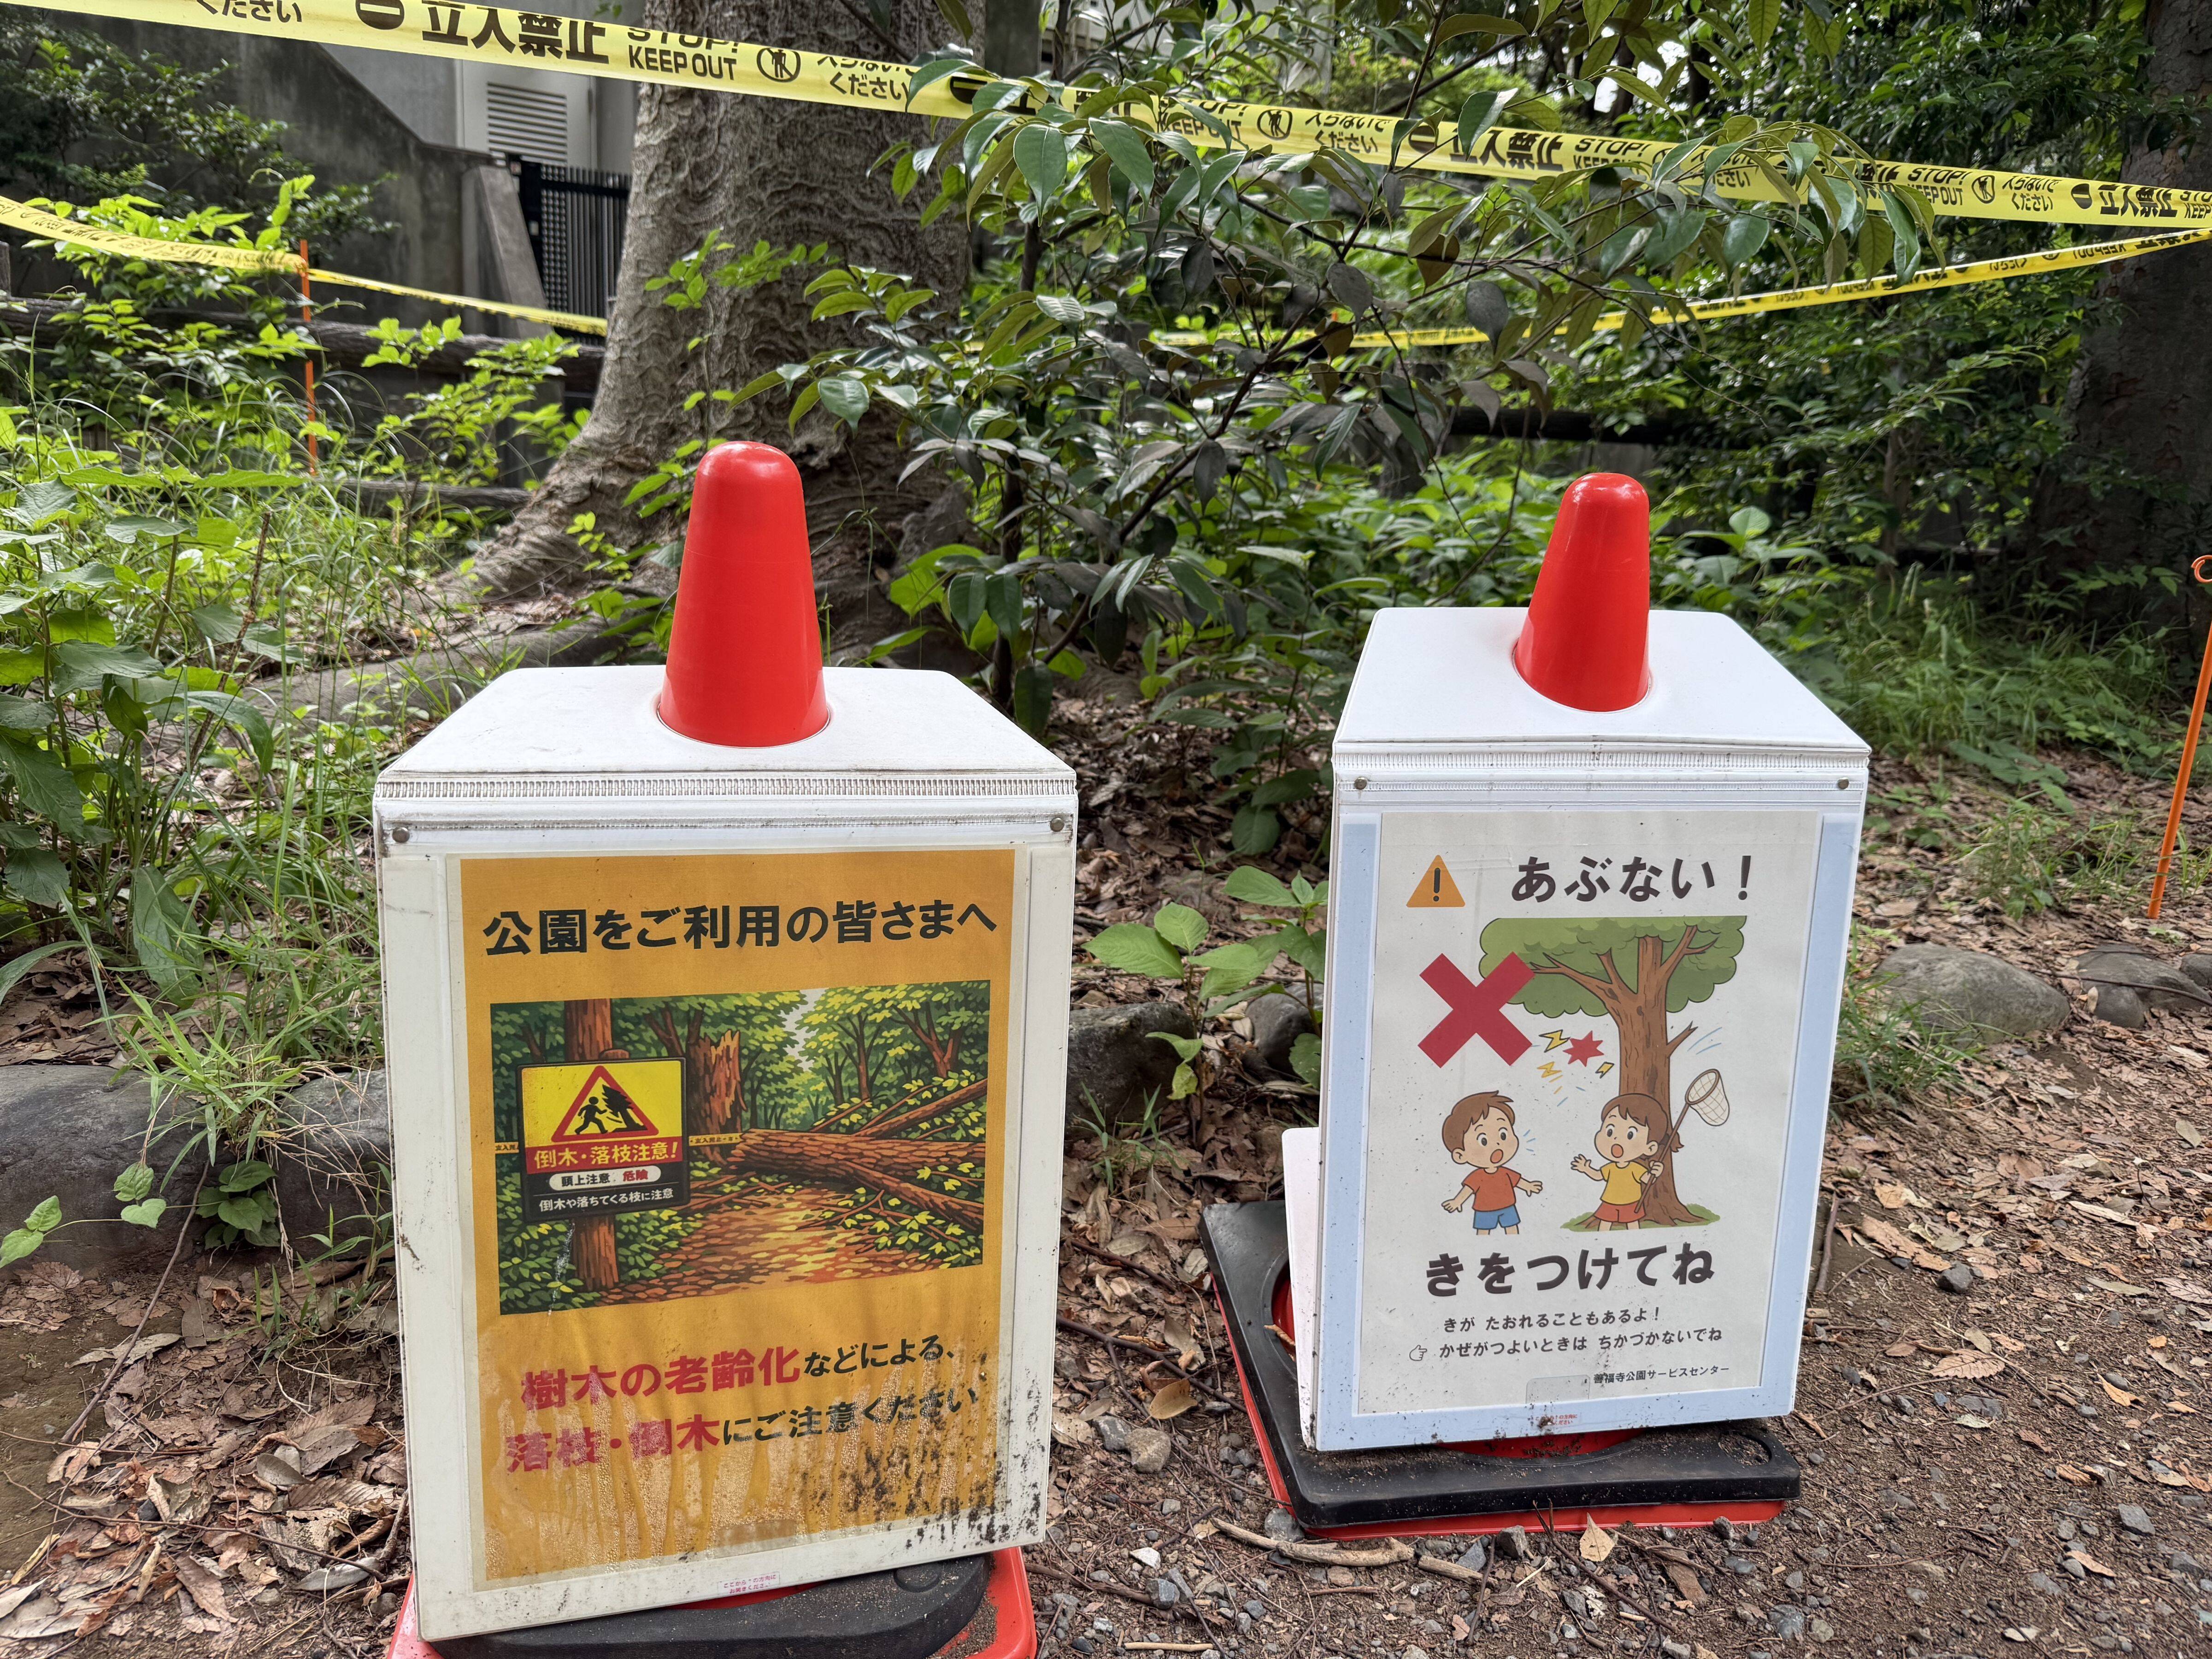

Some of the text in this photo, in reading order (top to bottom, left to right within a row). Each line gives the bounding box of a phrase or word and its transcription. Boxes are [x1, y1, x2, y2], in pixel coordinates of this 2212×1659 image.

[422, 0, 609, 65] 立入禁止
[629, 45, 736, 81] KEEP OUT
[830, 71, 910, 100] ください
[1305, 112, 1393, 132] 入らないで
[1315, 129, 1378, 153] ください
[1575, 138, 1652, 157] STOP!
[1907, 167, 1972, 185] STOP!
[2002, 174, 2063, 193] 入らないで
[1940, 187, 1963, 206] OUT
[2012, 193, 2053, 212] ください
[2098, 184, 2177, 218] 立入禁止
[2183, 203, 2212, 218] KEEP
[1512, 855, 1751, 903] あぶない！
[482, 900, 997, 956] 公園をご利用の皆さまへ
[535, 1141, 678, 1169] 倒木・落枝注意!
[561, 1169, 648, 1187] 頭上注意 危険
[539, 1188, 674, 1212] 倒木や落ちてくる枝に注意
[1426, 1241, 1715, 1297] きをつけてね
[1444, 1307, 1659, 1333] きが たおれることもあるよ！
[1439, 1327, 1722, 1358] かぜがつよいときは ちかづかないでね
[521, 1335, 954, 1411] 樹木の老齢化などによる、
[1594, 1365, 1729, 1383] 善福寺公園サービスセンター
[506, 1387, 979, 1472] 落枝・倒木にご注意ください
